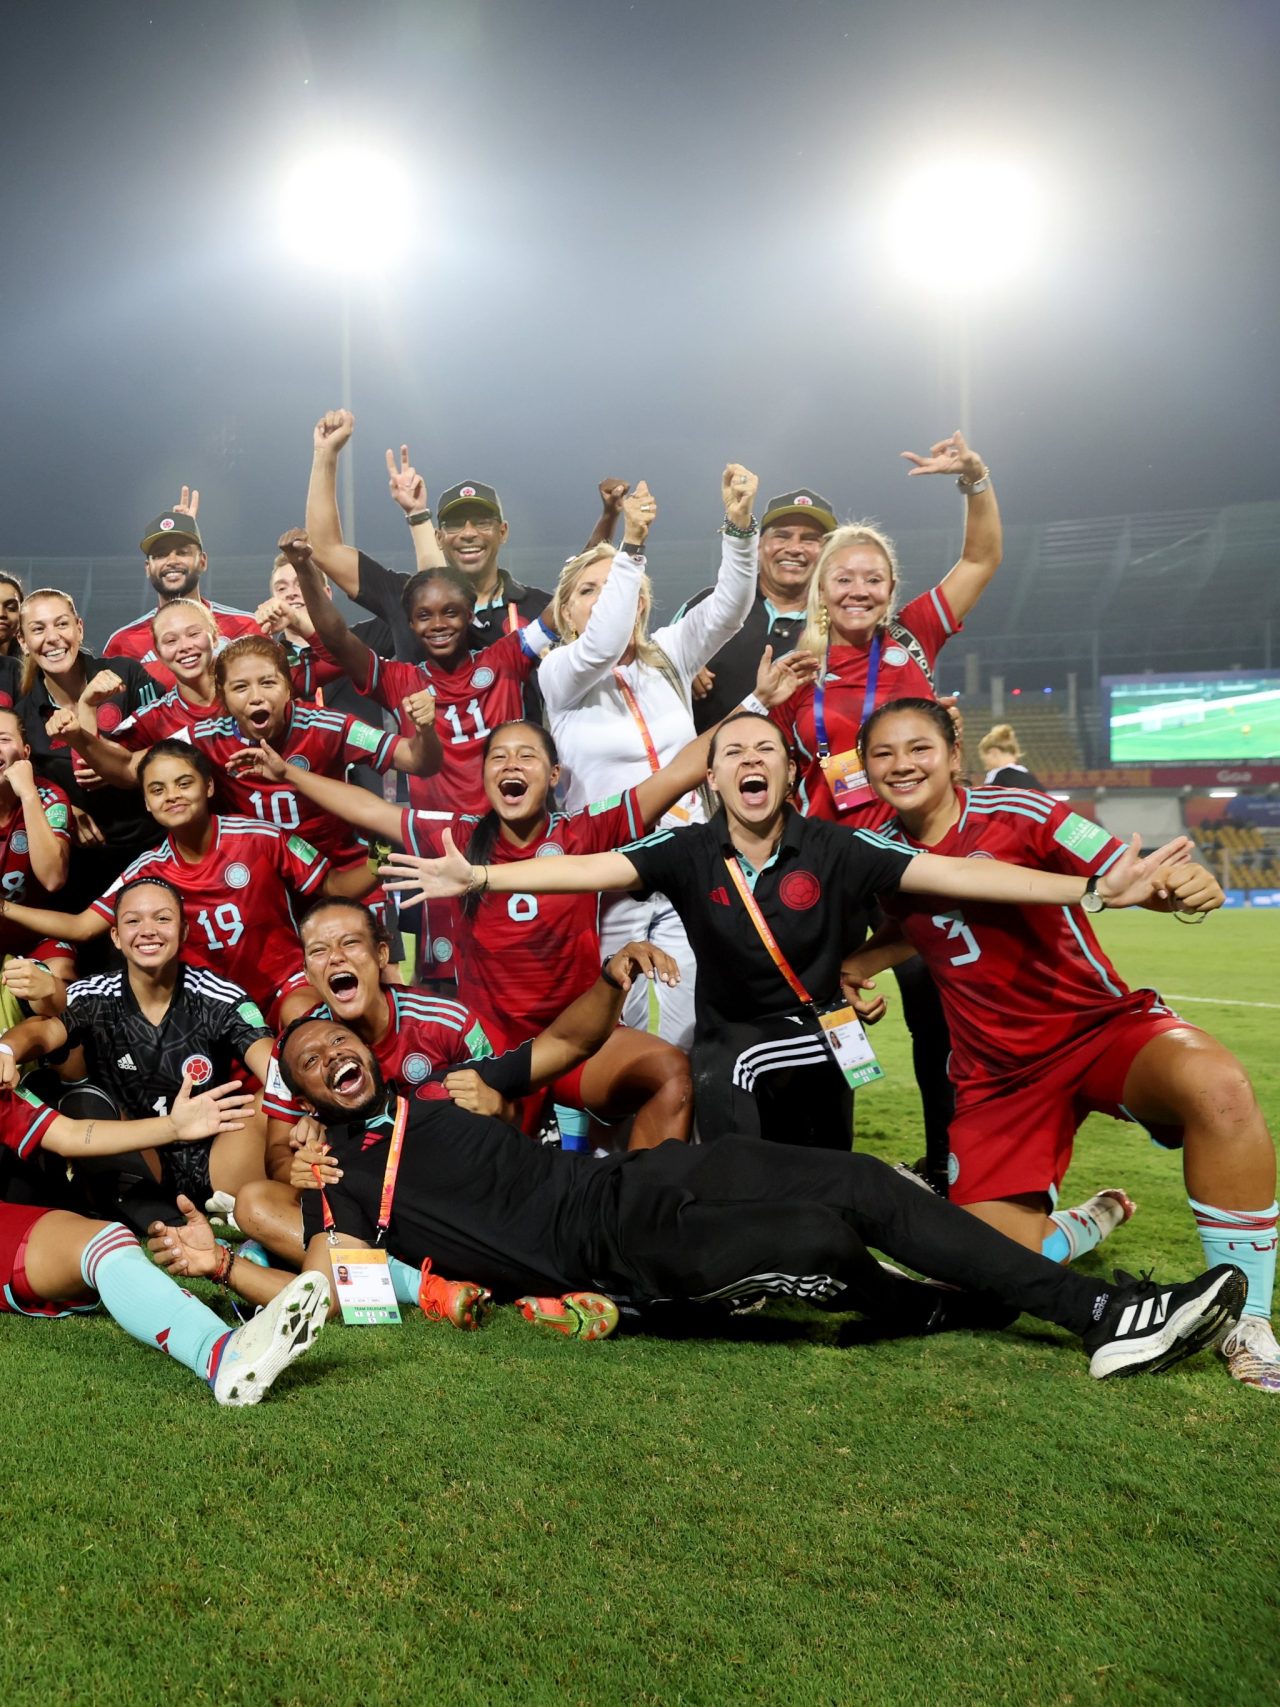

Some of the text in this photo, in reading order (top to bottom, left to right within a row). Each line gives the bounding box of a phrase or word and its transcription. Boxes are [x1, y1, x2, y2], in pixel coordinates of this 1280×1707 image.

[444, 698, 491, 744] 11
[834, 779, 848, 795] A
[1216, 769, 1253, 783] Goa
[249, 790, 300, 829] 10
[197, 903, 244, 951] 19
[931, 910, 982, 967] 3
